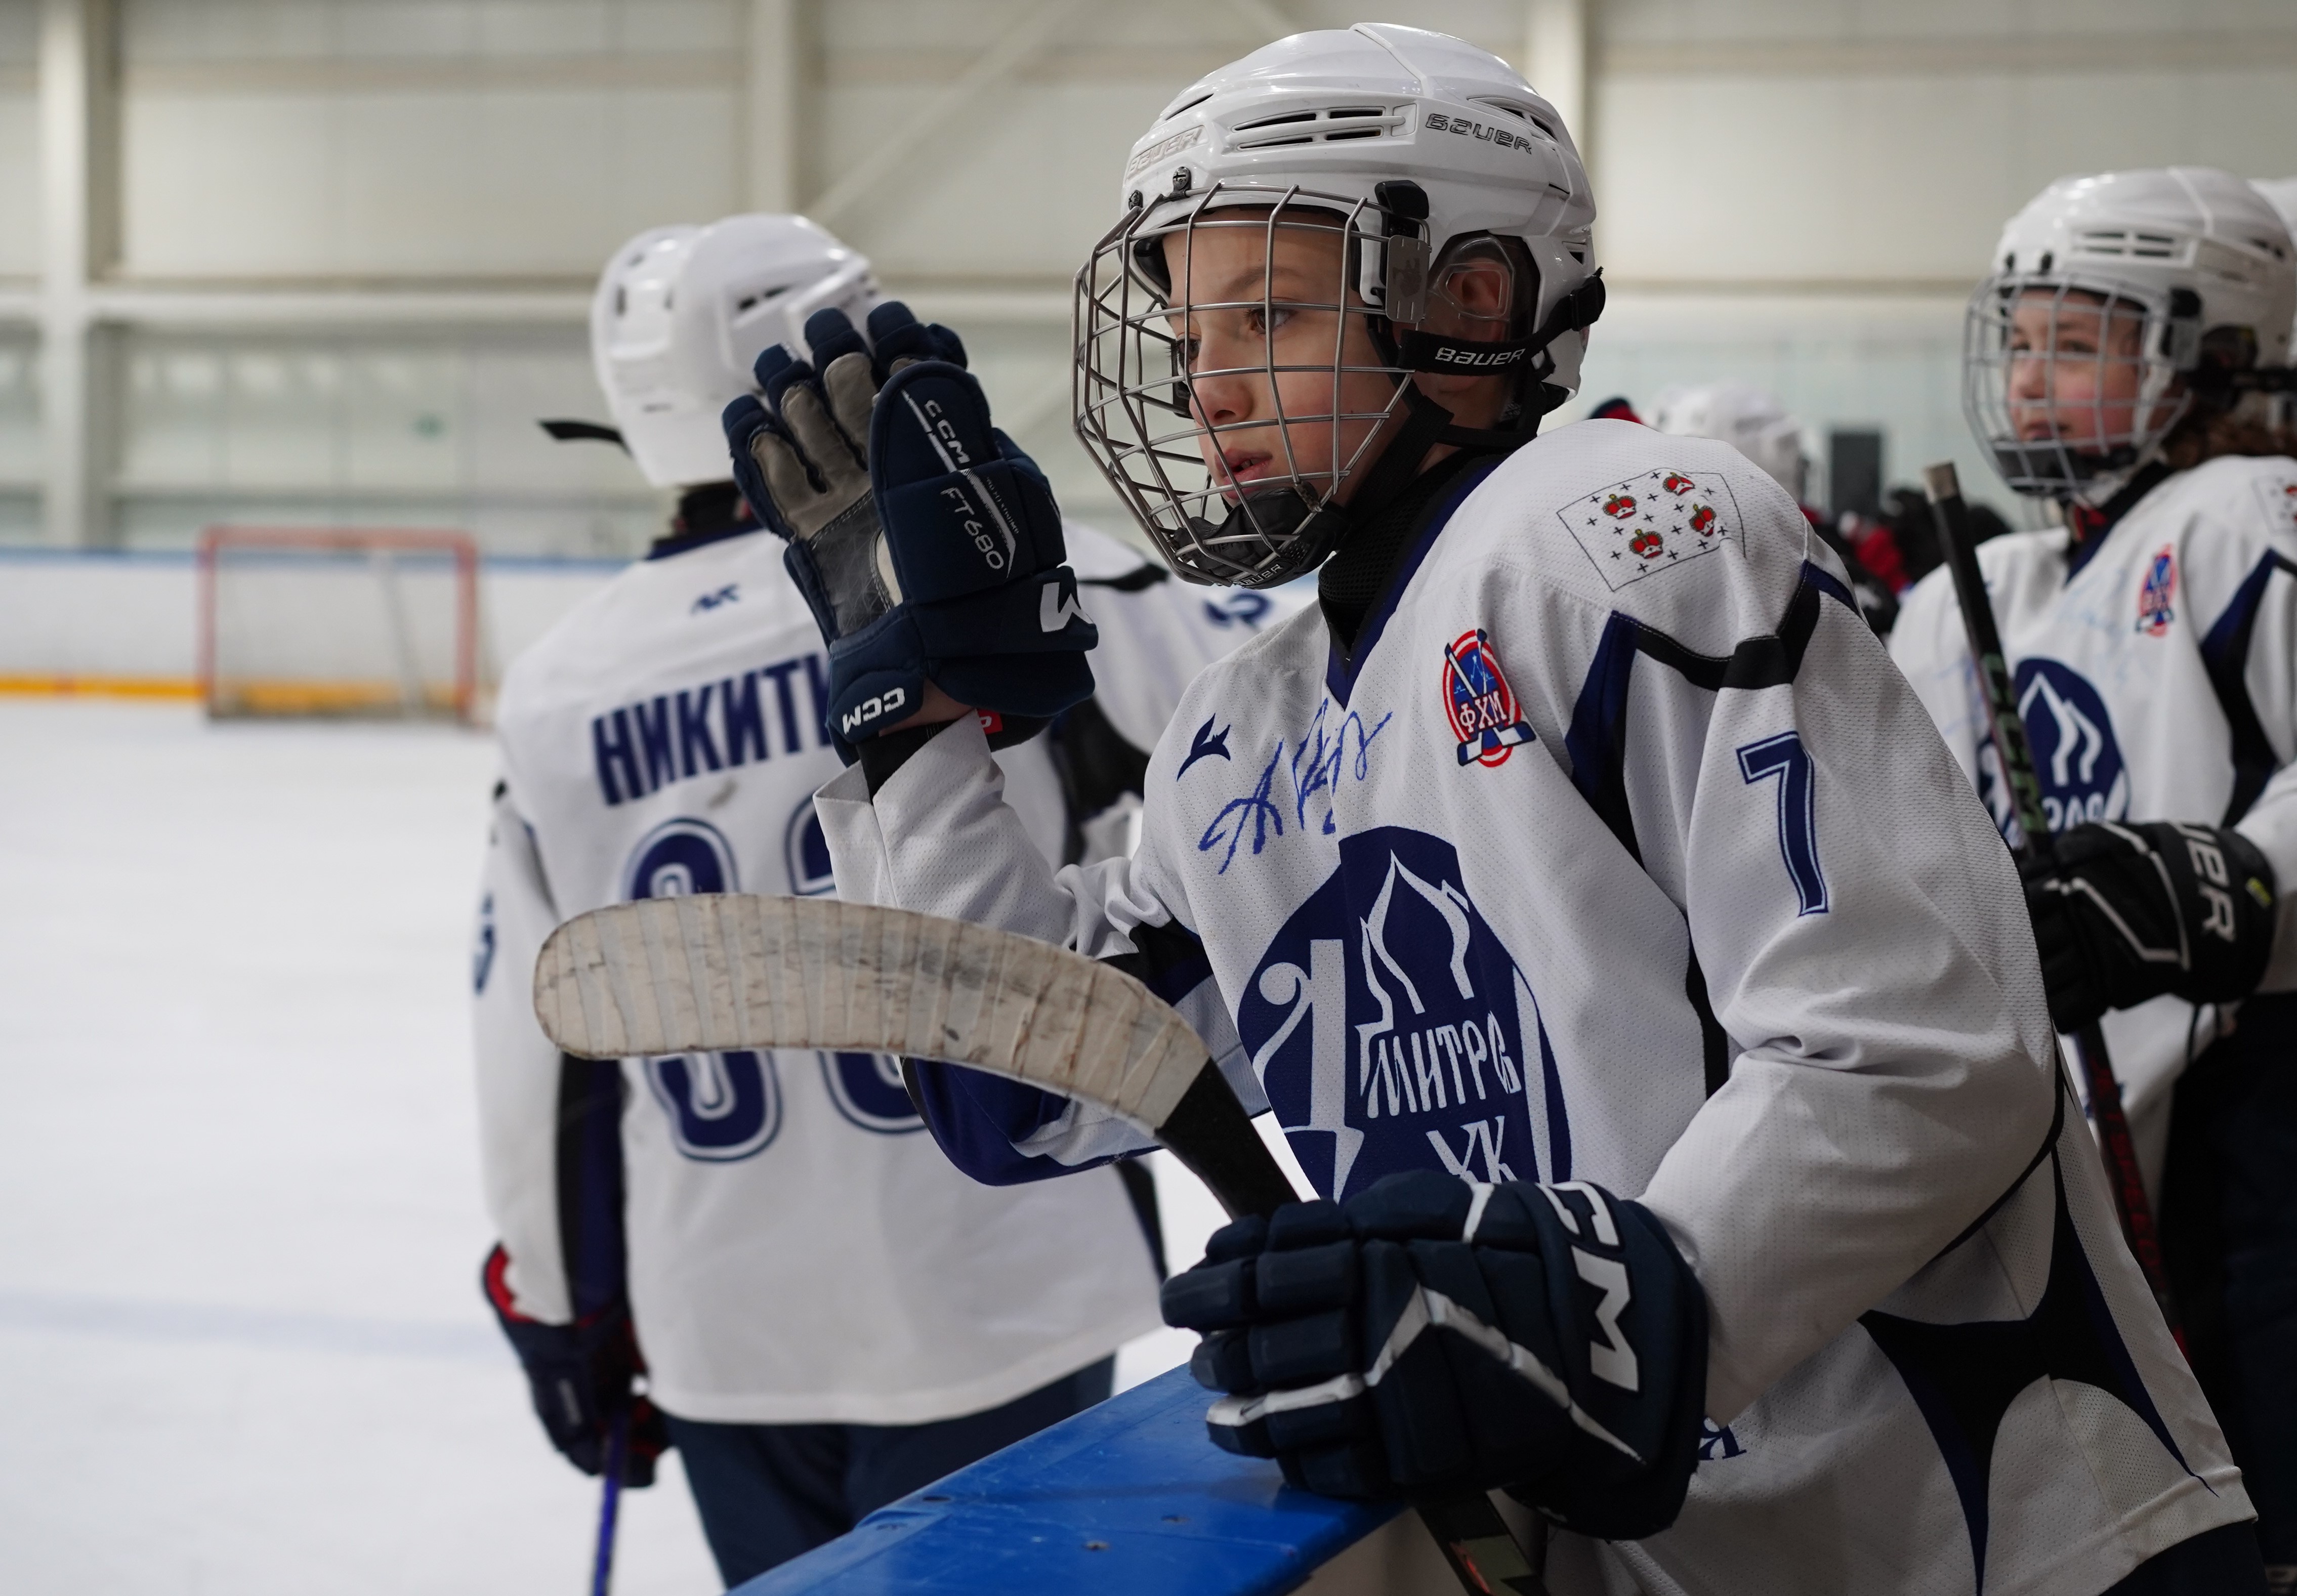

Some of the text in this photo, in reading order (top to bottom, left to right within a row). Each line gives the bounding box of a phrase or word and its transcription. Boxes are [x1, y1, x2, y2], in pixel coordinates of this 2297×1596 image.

[925, 400, 970, 464] CCM
[940, 487, 1005, 569] FT680
[843, 687, 905, 735] CCM
[1459, 690, 1508, 733] ФХМ
[1736, 730, 1828, 917] 7
[1535, 1181, 1640, 1393] CM
